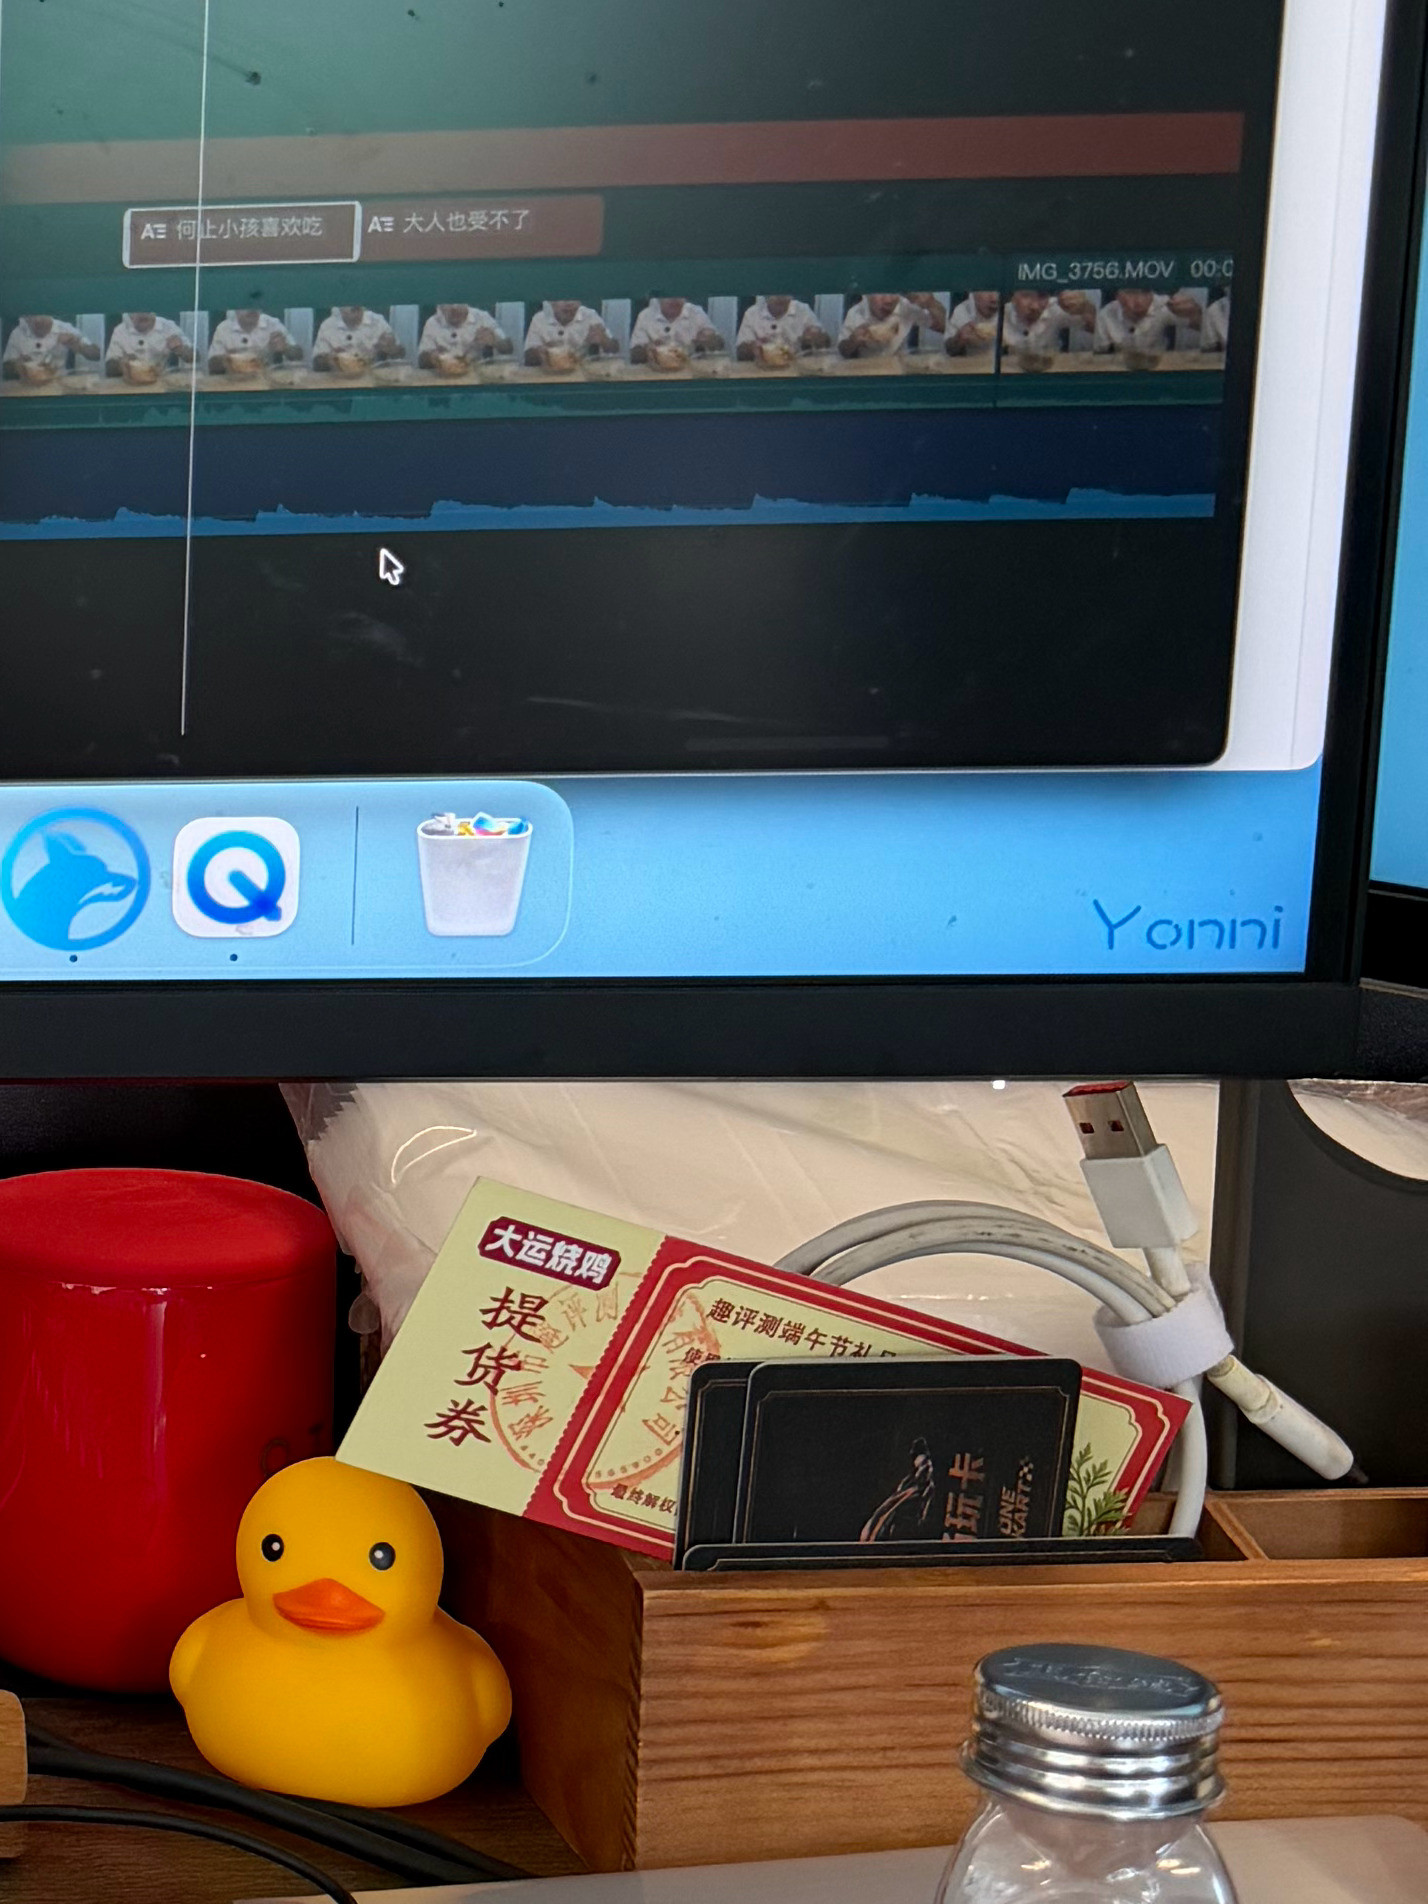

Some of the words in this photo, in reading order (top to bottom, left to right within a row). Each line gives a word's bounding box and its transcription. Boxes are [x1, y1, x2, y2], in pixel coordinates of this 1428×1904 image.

[403, 208, 531, 233] 大人也受不了
[1018, 260, 1174, 284] IMG_3756.MOV
[1092, 899, 1284, 950] Yonni
[486, 1223, 614, 1287] 大运烧鸡
